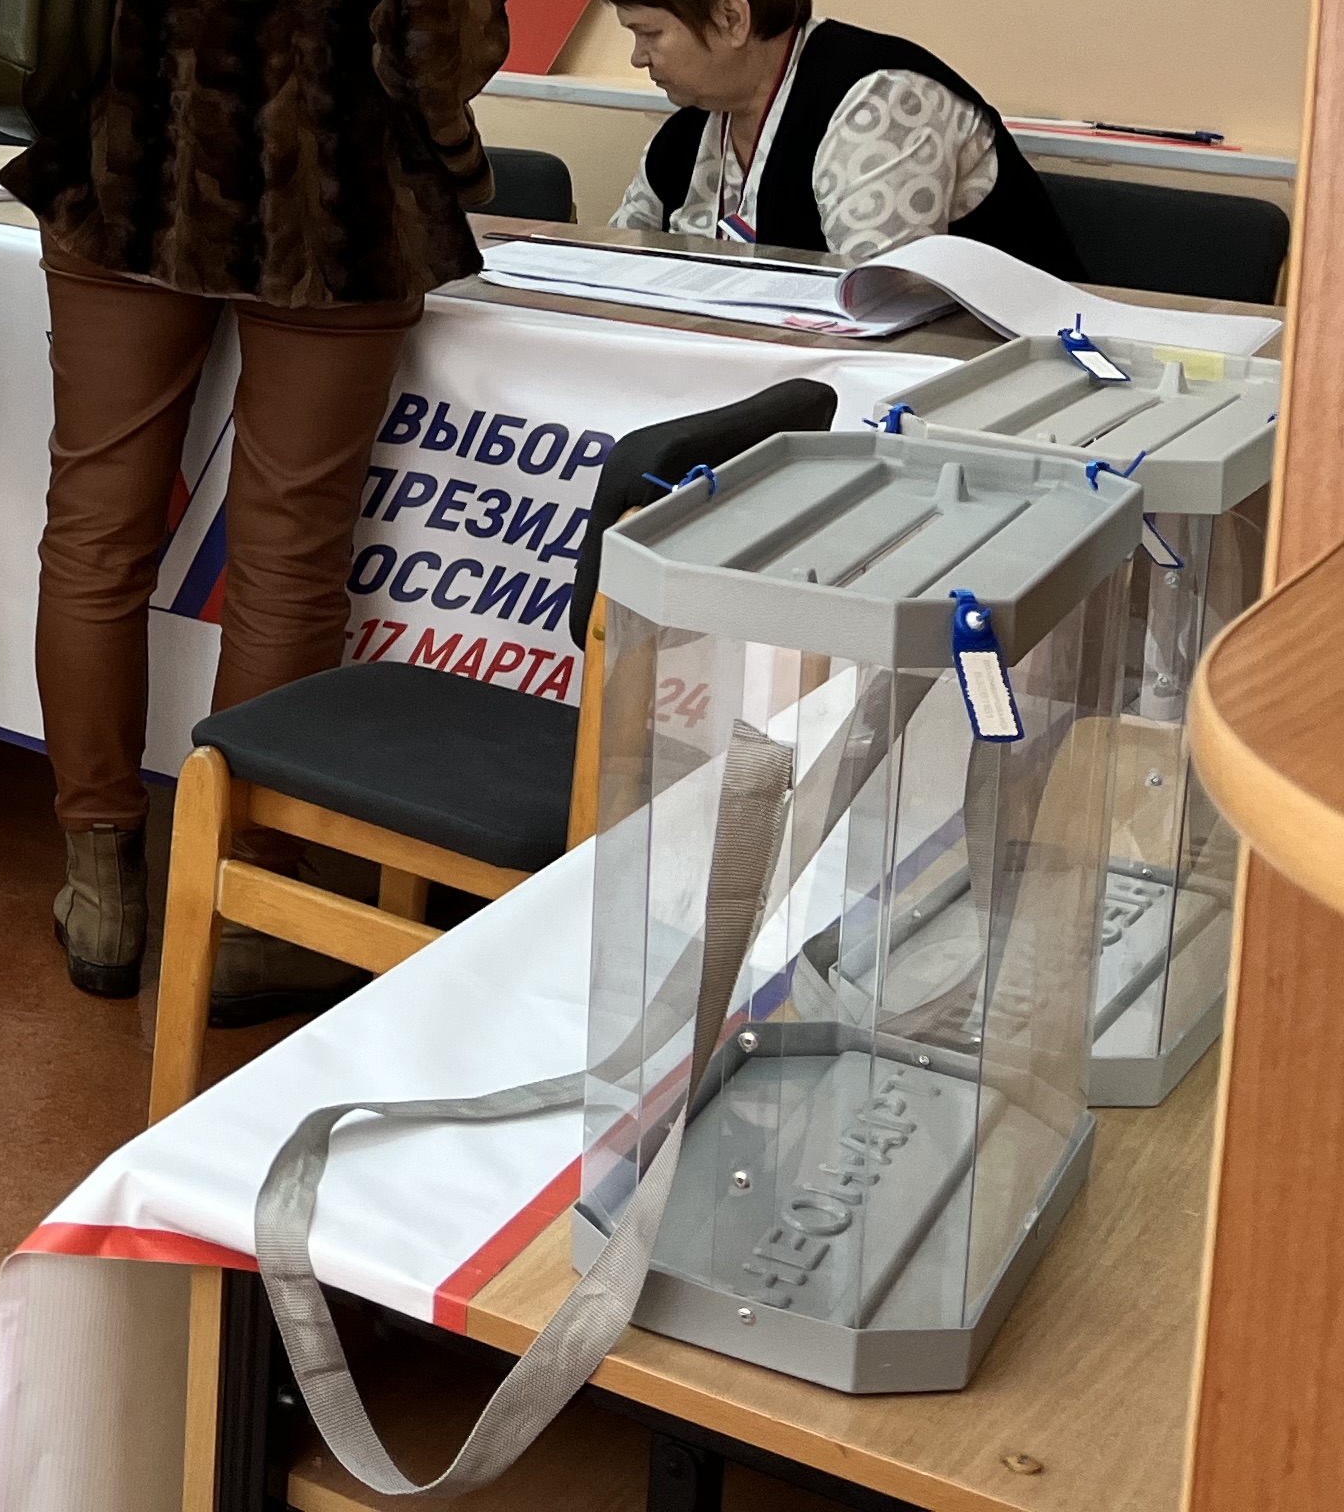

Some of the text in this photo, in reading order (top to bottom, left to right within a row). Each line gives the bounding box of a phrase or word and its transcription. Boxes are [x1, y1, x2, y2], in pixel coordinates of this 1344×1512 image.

[376, 392, 616, 481] ВЫБОР
[361, 465, 591, 569] ПРЕЗИД
[348, 544, 575, 631] ОССИИ
[408, 628, 575, 700] МАРТА
[653, 677, 711, 729] 24
